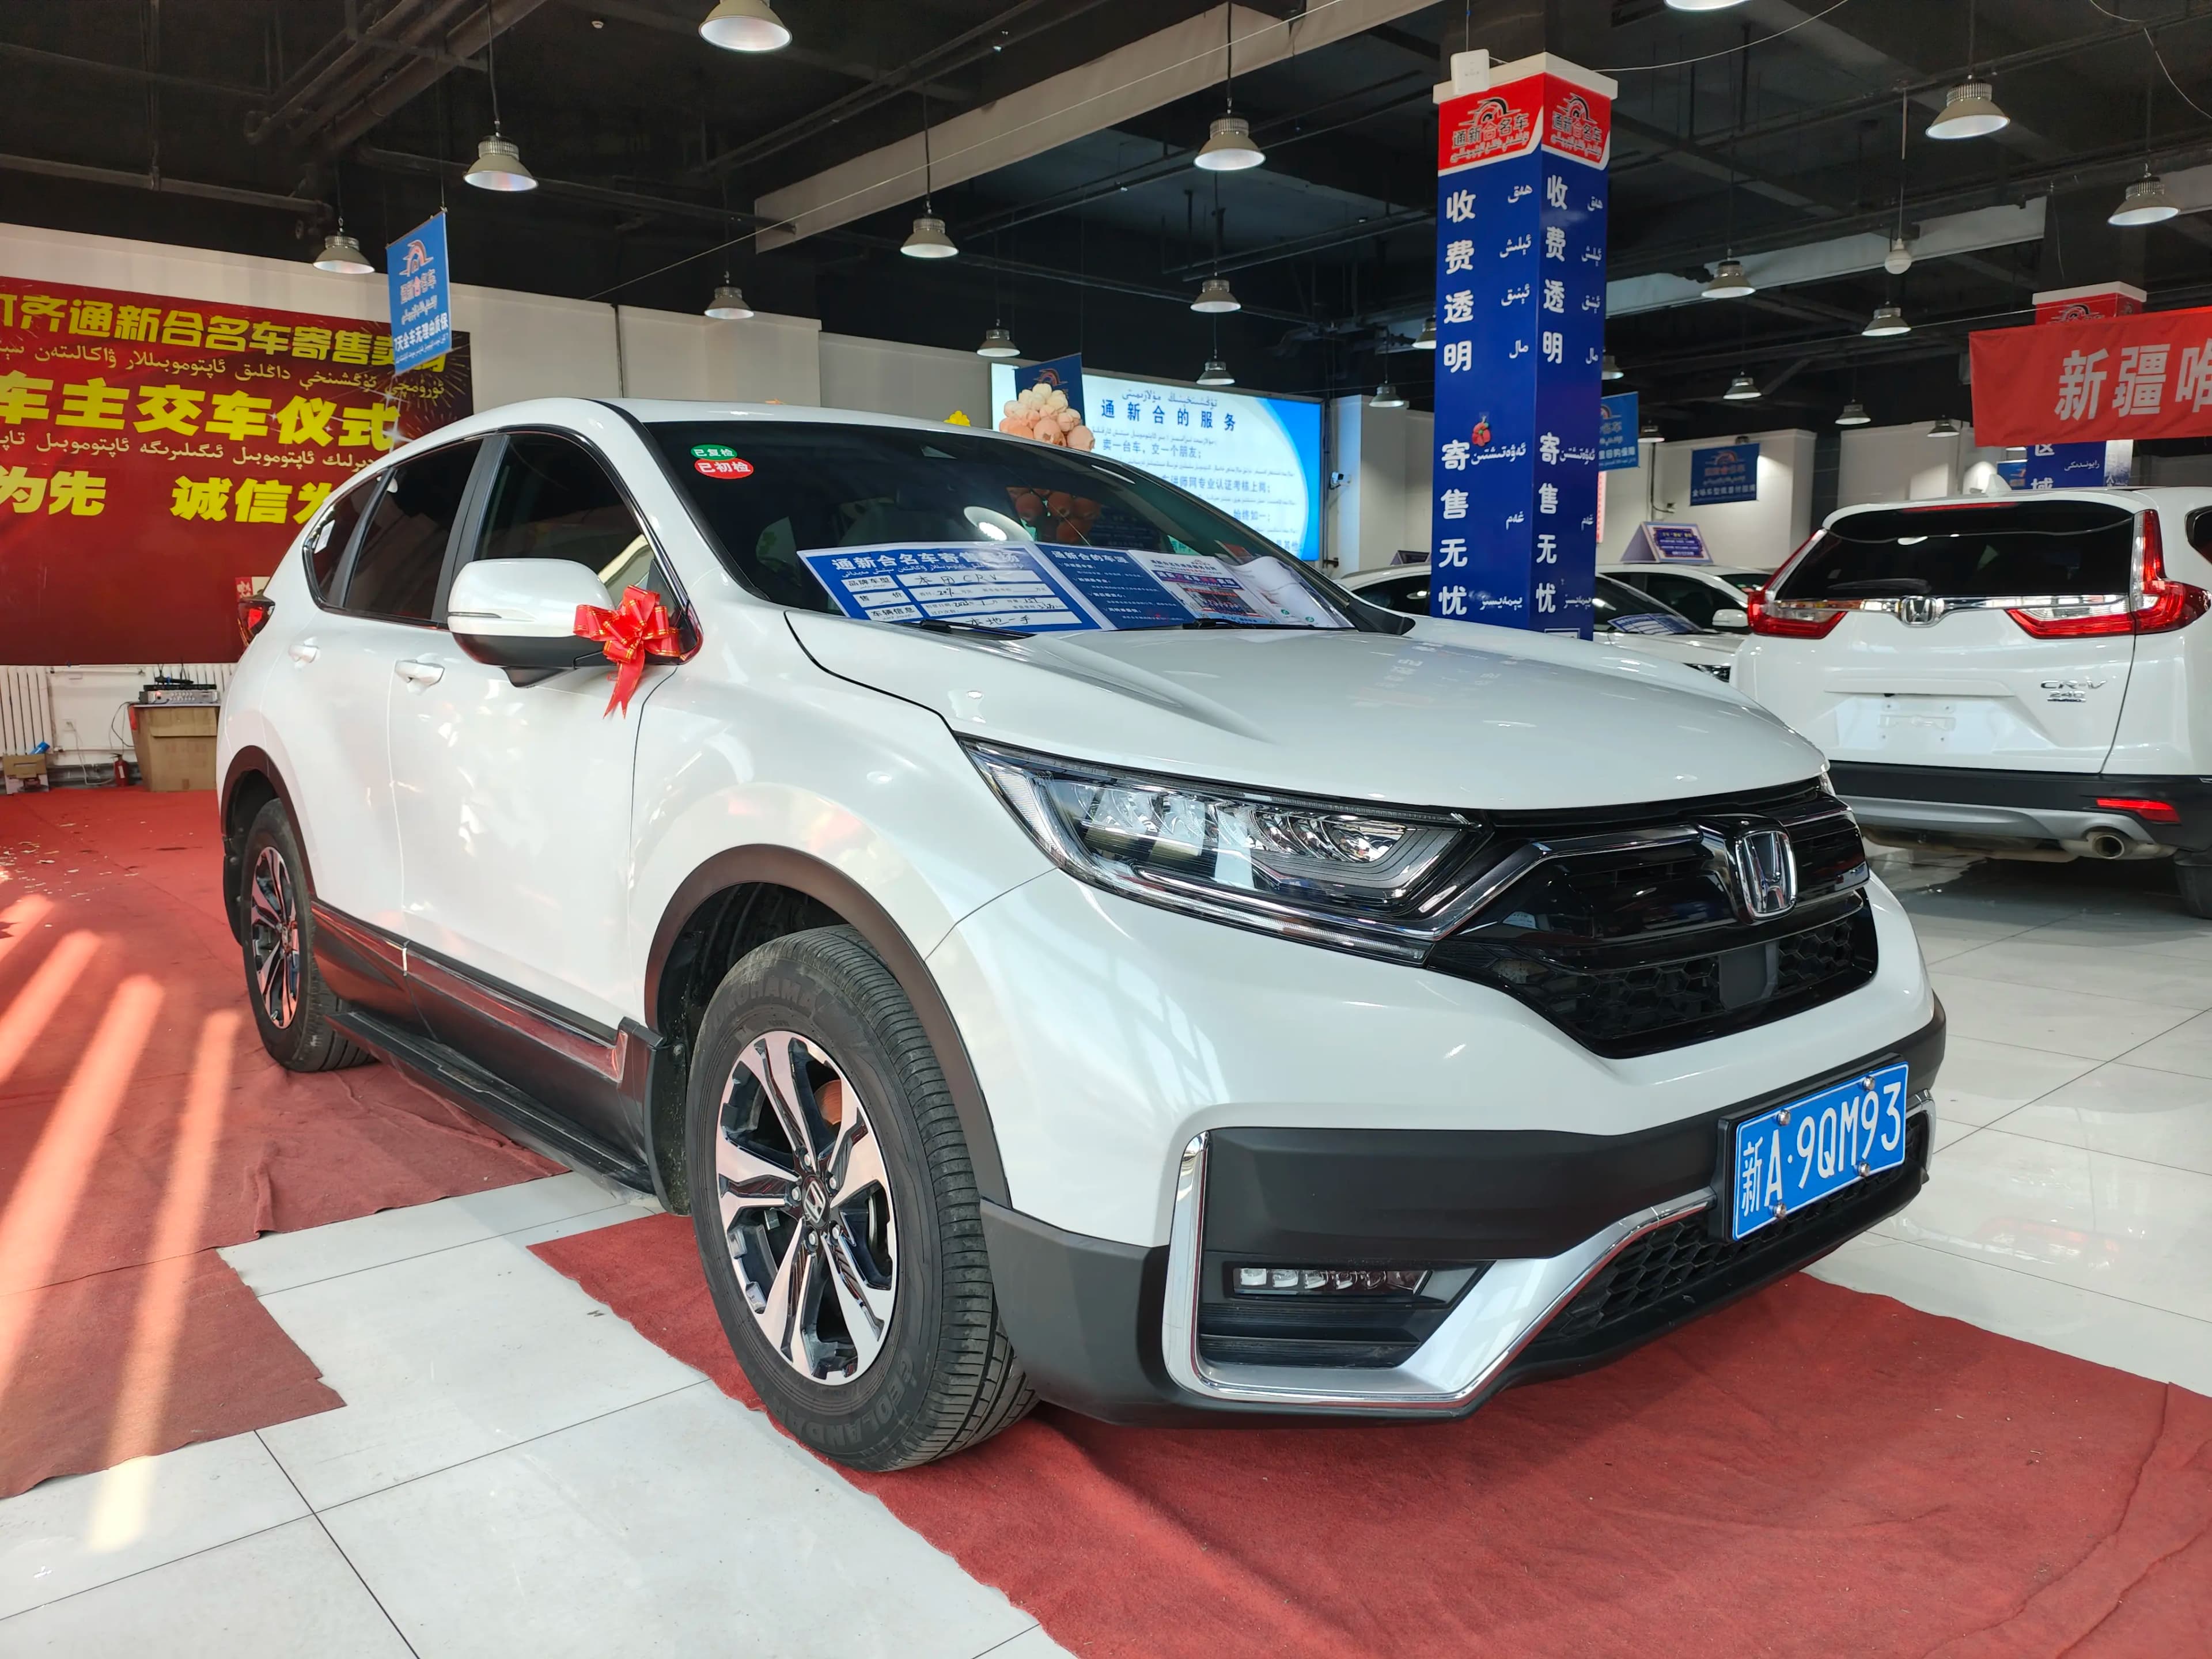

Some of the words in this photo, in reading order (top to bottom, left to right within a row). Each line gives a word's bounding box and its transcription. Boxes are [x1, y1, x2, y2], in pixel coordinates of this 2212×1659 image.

[1453, 113, 1529, 149] 通新合名车
[1444, 190, 1476, 373] 收费透明
[1543, 175, 1567, 364] 收费透明
[0, 293, 447, 372] 齐通新合名车寄售卖
[1509, 340, 1528, 358] مال
[0, 369, 400, 452] 车主交车仪式
[1101, 399, 1236, 431] 通新合的服务
[698, 461, 751, 472] 已初检
[1438, 439, 1471, 615] 寄售无忧
[1536, 432, 1560, 613] 寄售无忧
[831, 552, 1020, 570] 通新合名车寄售场
[849, 577, 891, 586] 品牌车型
[871, 607, 915, 617] 车辆信息
[2040, 680, 2107, 690] CR-V
